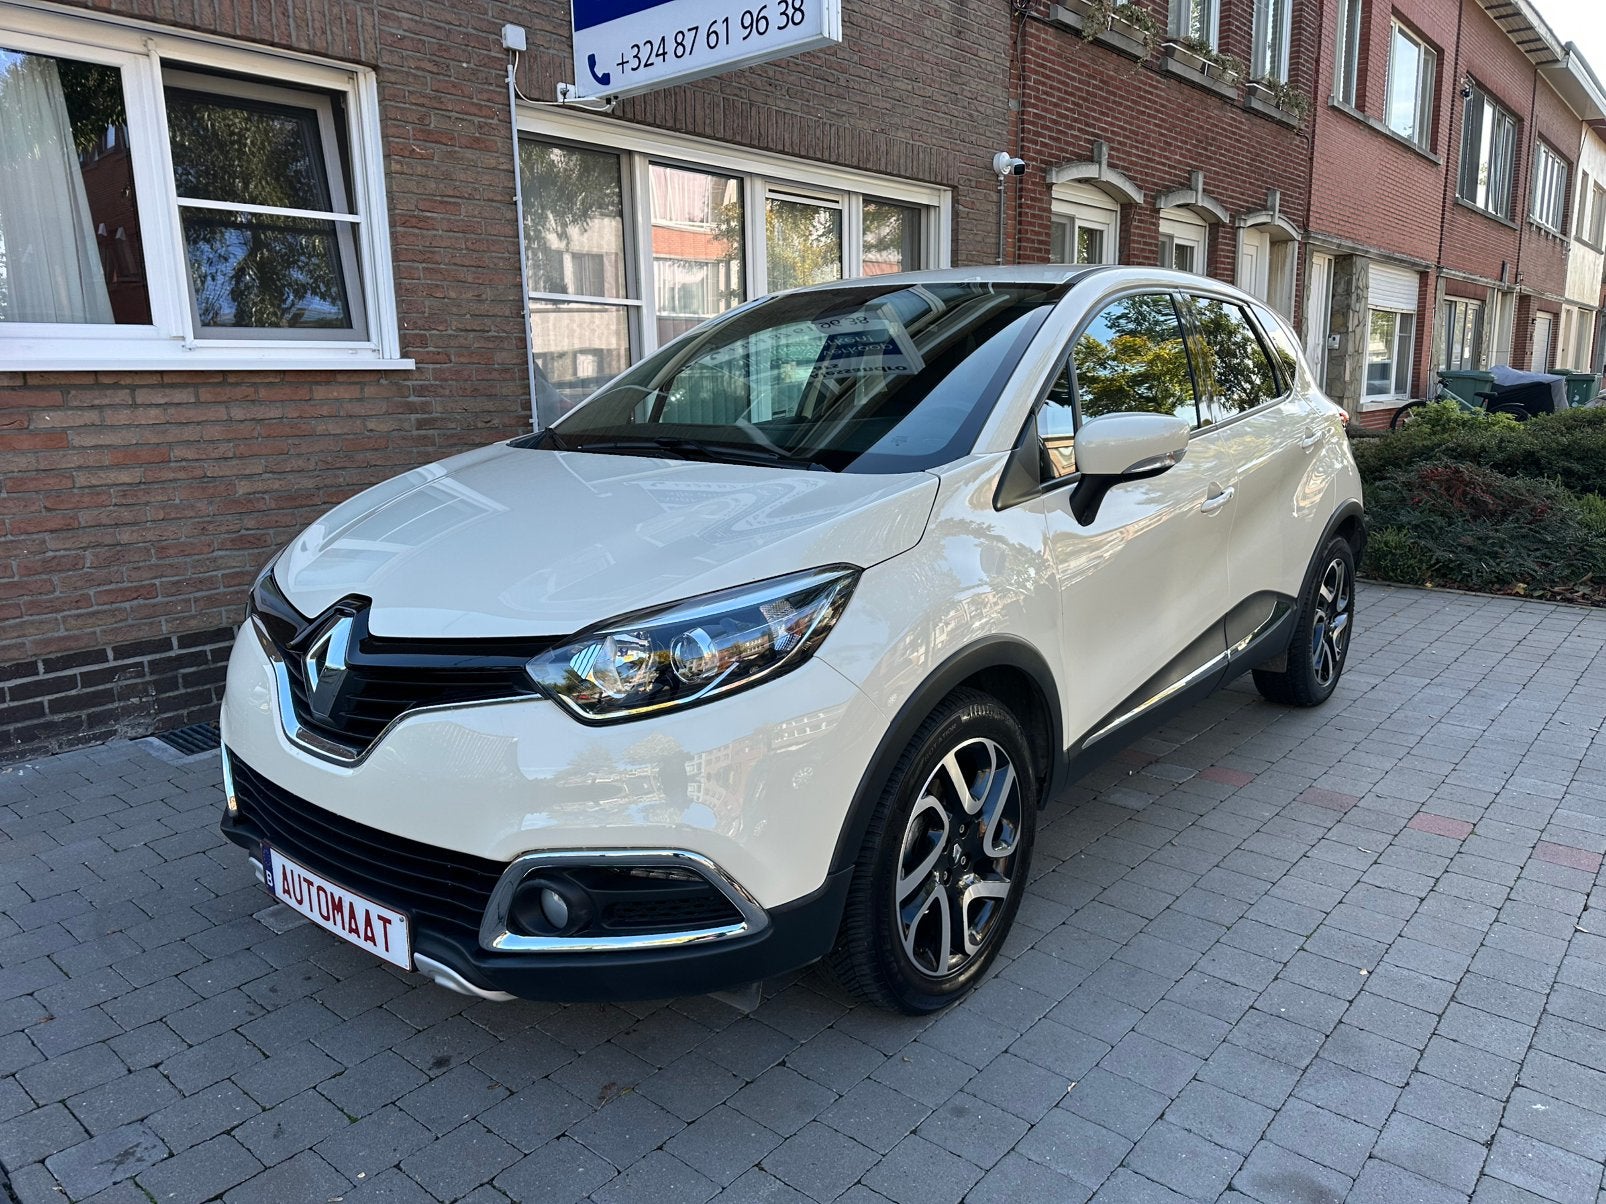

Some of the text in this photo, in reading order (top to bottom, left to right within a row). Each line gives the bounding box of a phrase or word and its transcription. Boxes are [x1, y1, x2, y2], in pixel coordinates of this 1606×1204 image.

[616, 0, 806, 75] +324 87 61 96 38
[265, 870, 274, 887] B
[281, 863, 392, 953] AUTOMAAT
